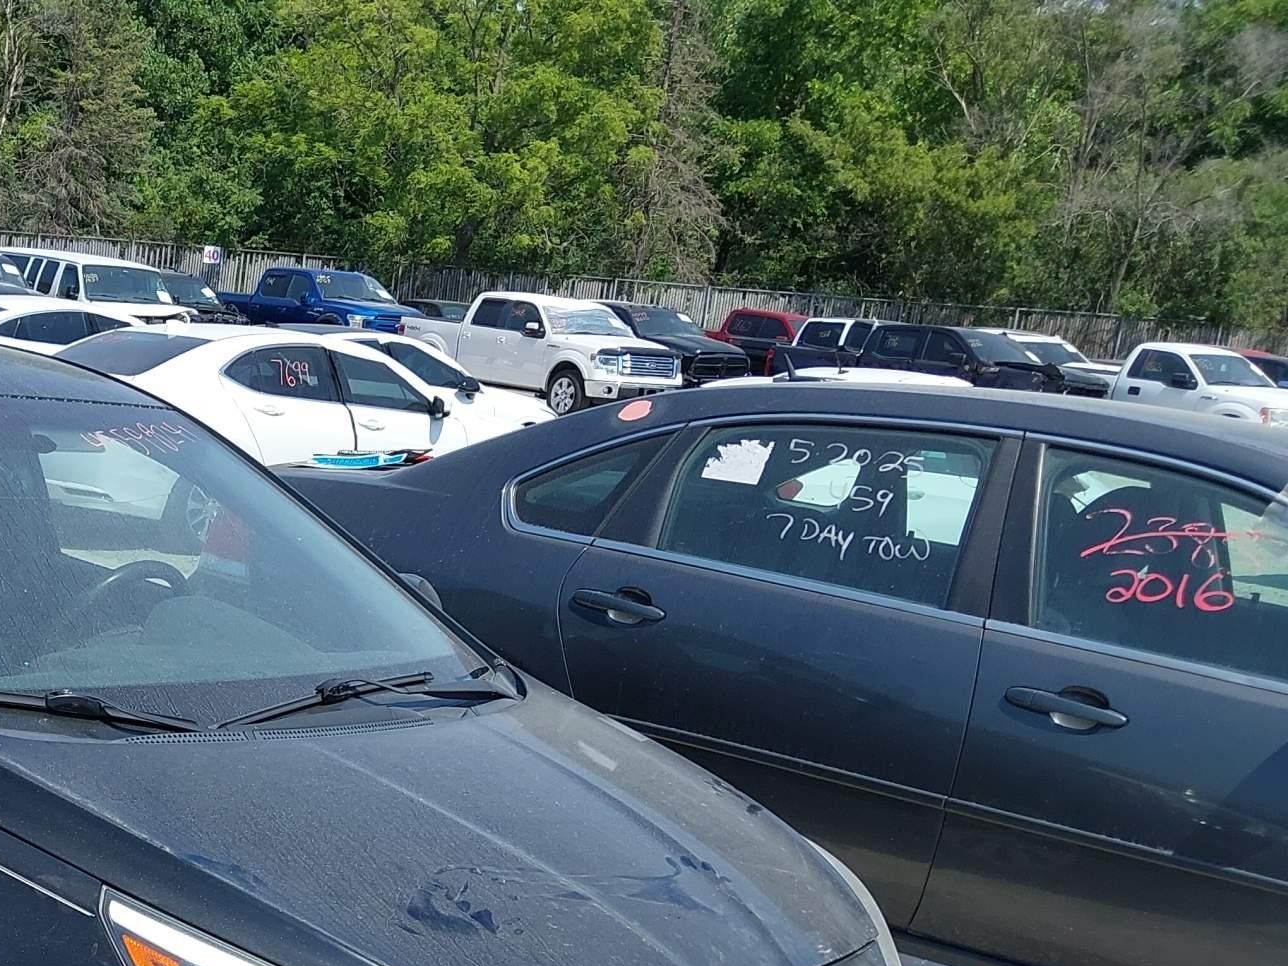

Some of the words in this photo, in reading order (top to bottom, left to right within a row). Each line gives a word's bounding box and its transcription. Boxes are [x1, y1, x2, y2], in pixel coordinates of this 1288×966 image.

[205, 249, 219, 261] 40
[271, 359, 313, 387] 7699
[767, 513, 794, 539] 7
[800, 518, 854, 561] DAY
[863, 529, 930, 561] TOW
[1106, 569, 1235, 612] 2016
